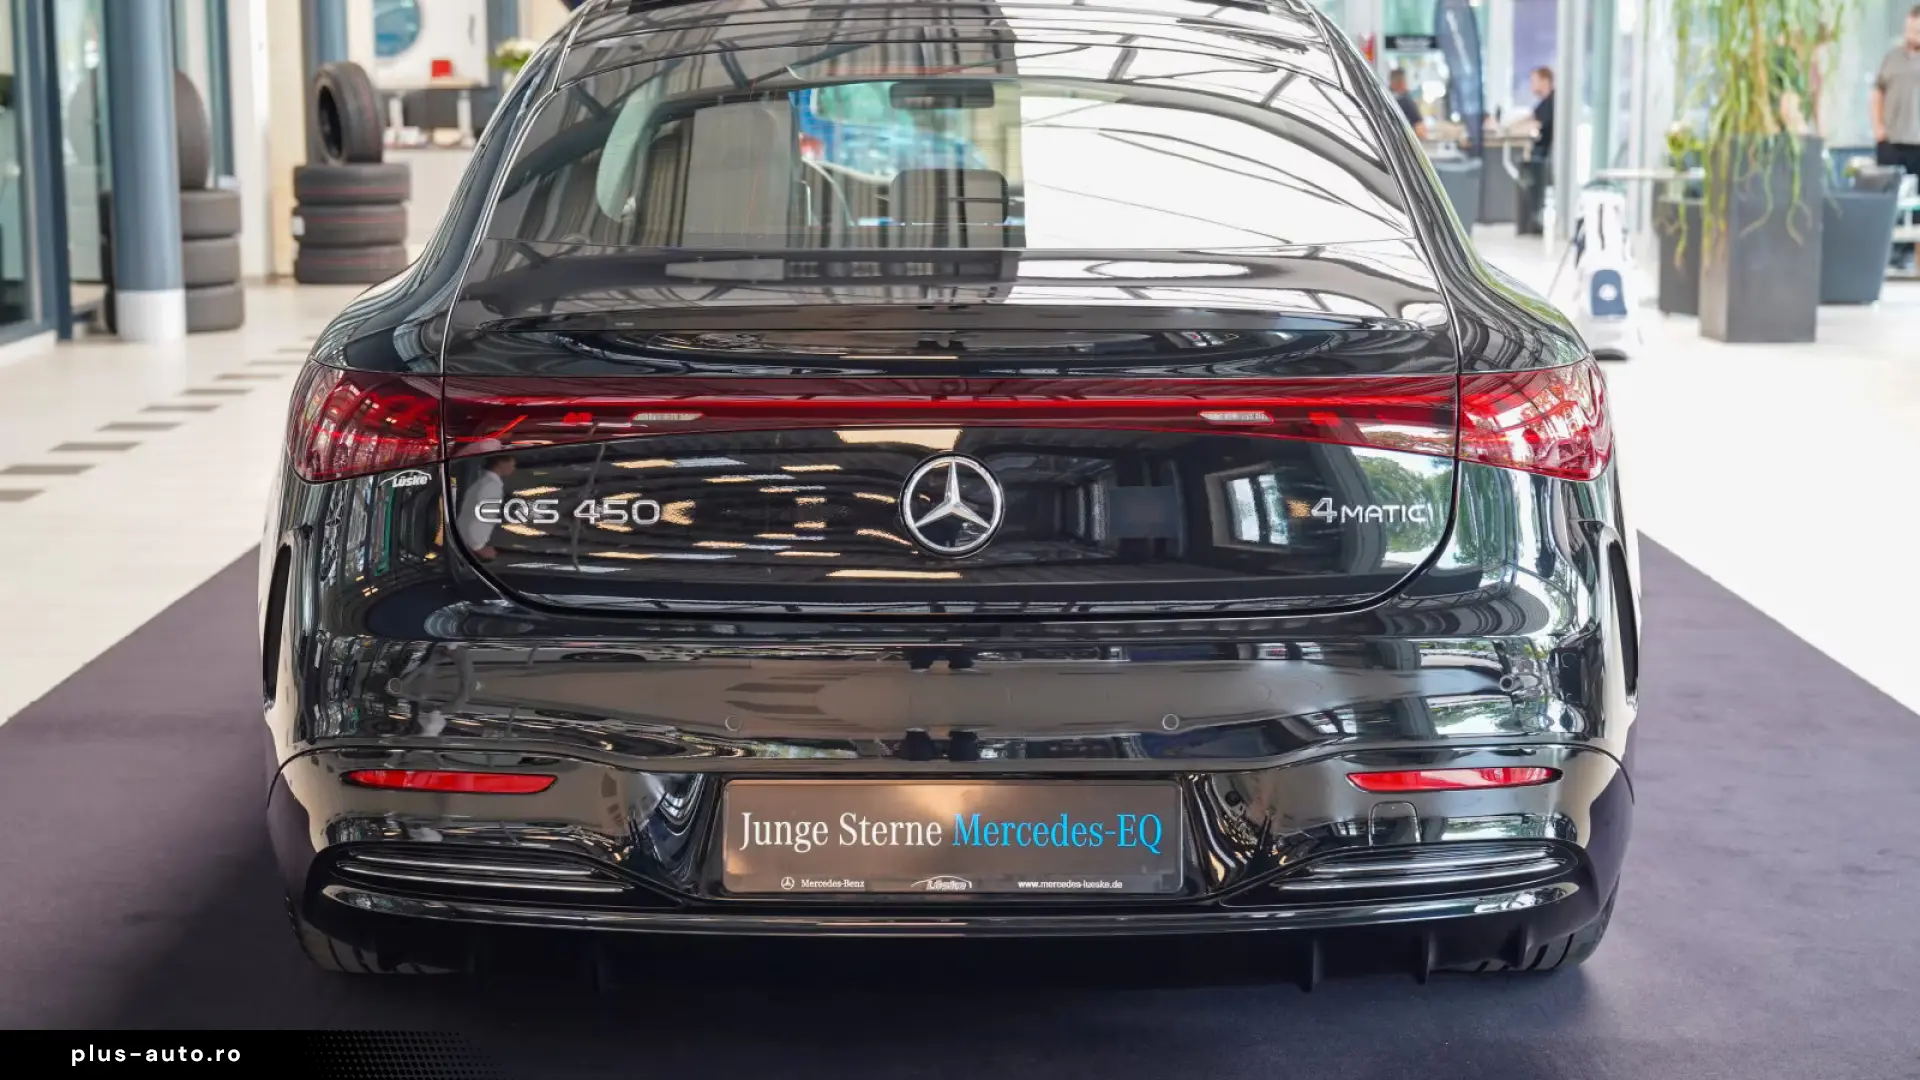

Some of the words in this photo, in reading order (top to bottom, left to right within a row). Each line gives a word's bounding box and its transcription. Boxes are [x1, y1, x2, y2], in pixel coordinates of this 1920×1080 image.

[474, 499, 560, 525] EQS
[573, 499, 661, 525] 450
[738, 811, 829, 853] Junge
[839, 811, 943, 846] Sterne
[951, 812, 1163, 854] Mercedes-EQ
[800, 878, 865, 889] Mercedes-Benz
[1017, 879, 1123, 889] www.mercedes-lueske.de
